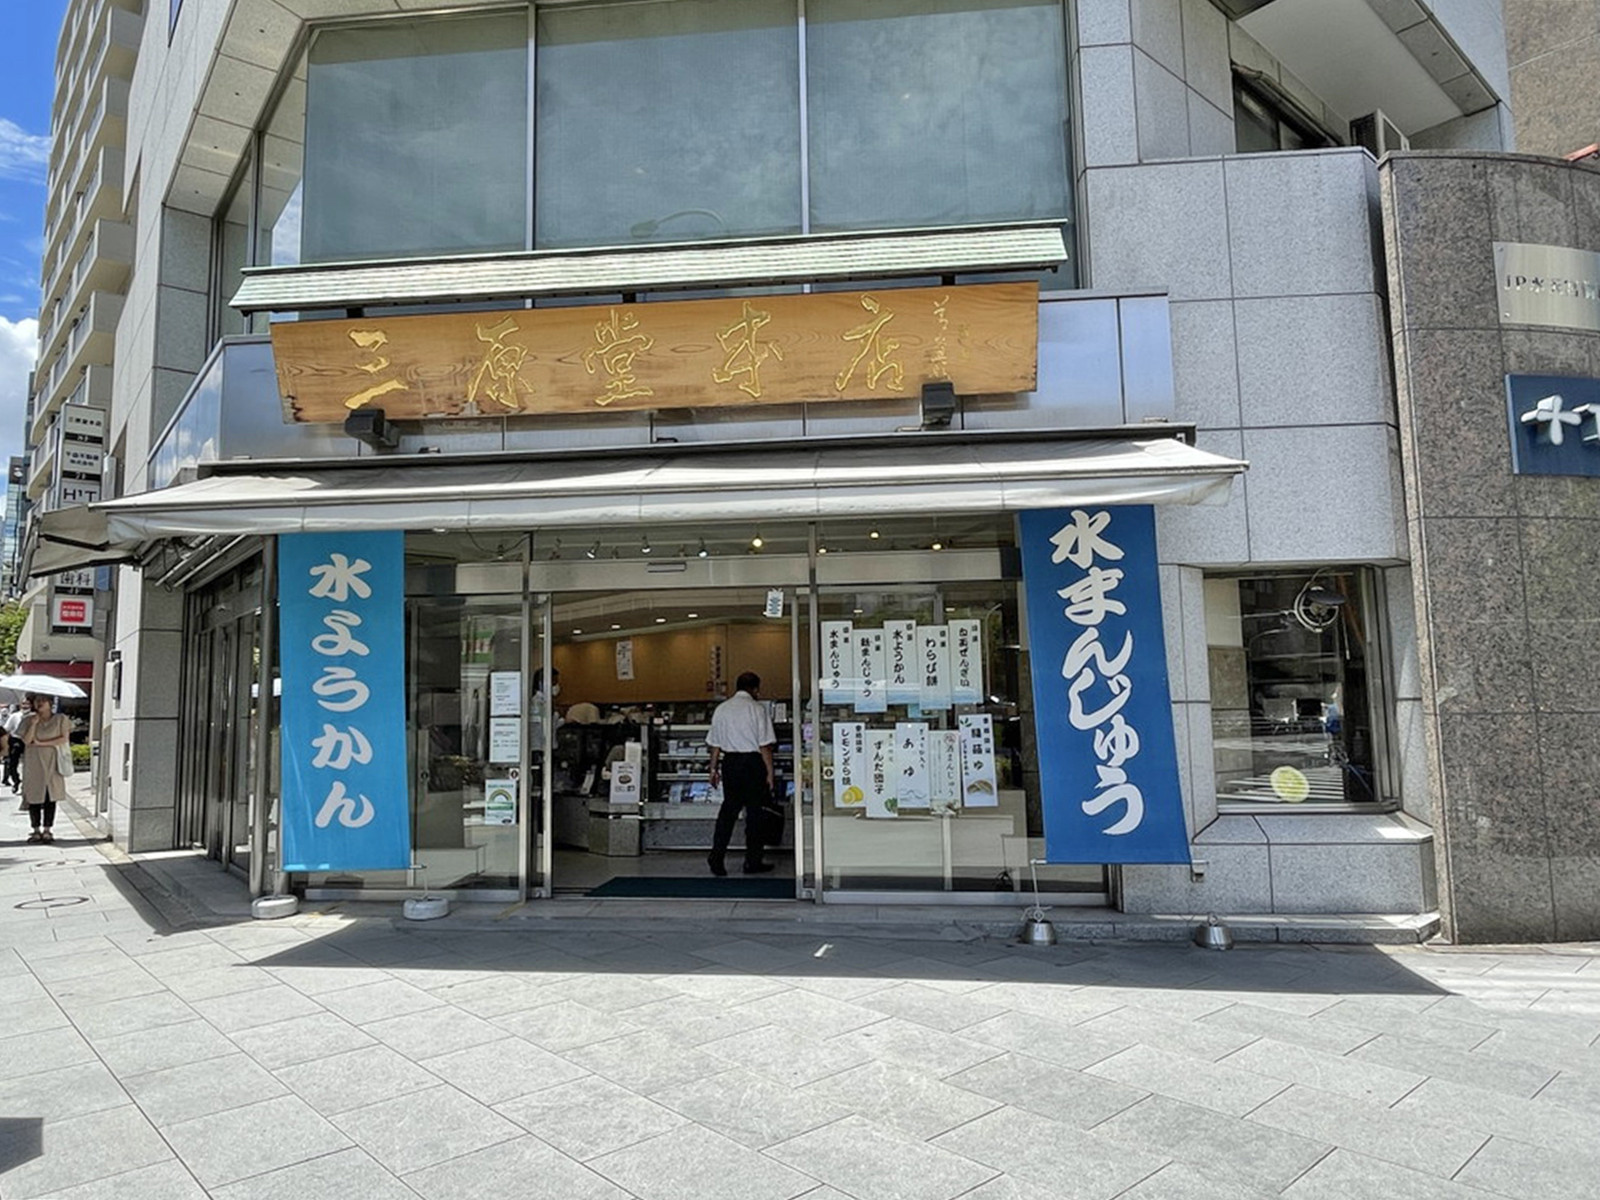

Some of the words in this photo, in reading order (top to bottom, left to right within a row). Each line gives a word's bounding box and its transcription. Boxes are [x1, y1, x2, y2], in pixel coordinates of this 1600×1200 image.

[345, 294, 904, 410] 三原堂本店
[829, 629, 841, 688] 水まんじゅう
[892, 629, 905, 684] 水ようかん
[1050, 509, 1144, 836] 水まんじゅう
[309, 553, 375, 829] 水ようかん
[841, 728, 852, 786] レモンどら焼
[902, 737, 915, 778] あゆ
